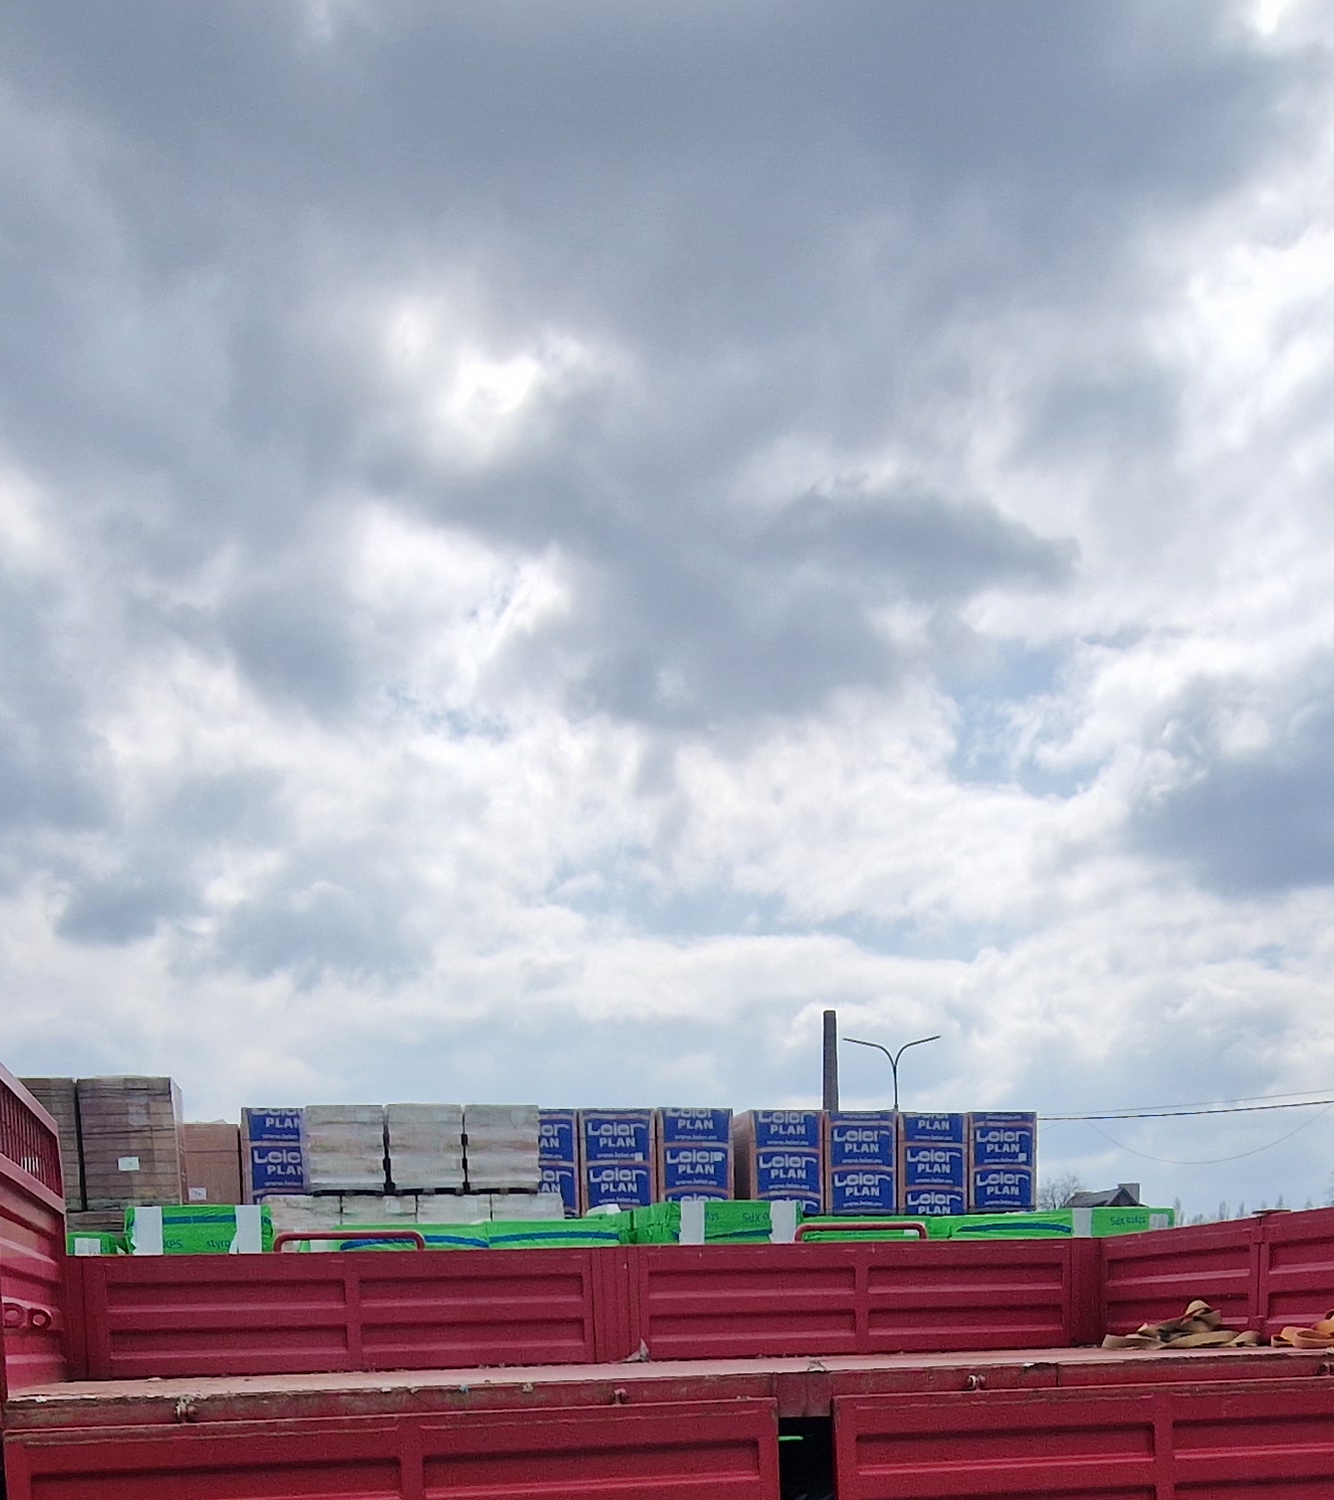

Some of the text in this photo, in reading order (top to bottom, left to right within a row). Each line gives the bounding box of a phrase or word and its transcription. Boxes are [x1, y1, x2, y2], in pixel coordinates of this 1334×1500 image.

[677, 1119, 714, 1130] PLAN
[770, 1124, 806, 1135] PLAN
[917, 1120, 950, 1131] PLAN
[599, 1137, 636, 1148] PLAN
[844, 1143, 880, 1153] PLAN
[986, 1143, 1020, 1153] PLAN
[254, 1149, 301, 1164] Leie
[678, 1164, 715, 1175] PLAN
[770, 1168, 807, 1179] PLAN
[917, 1163, 951, 1174] PLAN
[600, 1183, 637, 1193] PLAN
[845, 1187, 880, 1197] PLAN
[986, 1186, 1020, 1196] PLAN
[917, 1206, 951, 1215] PLAN
